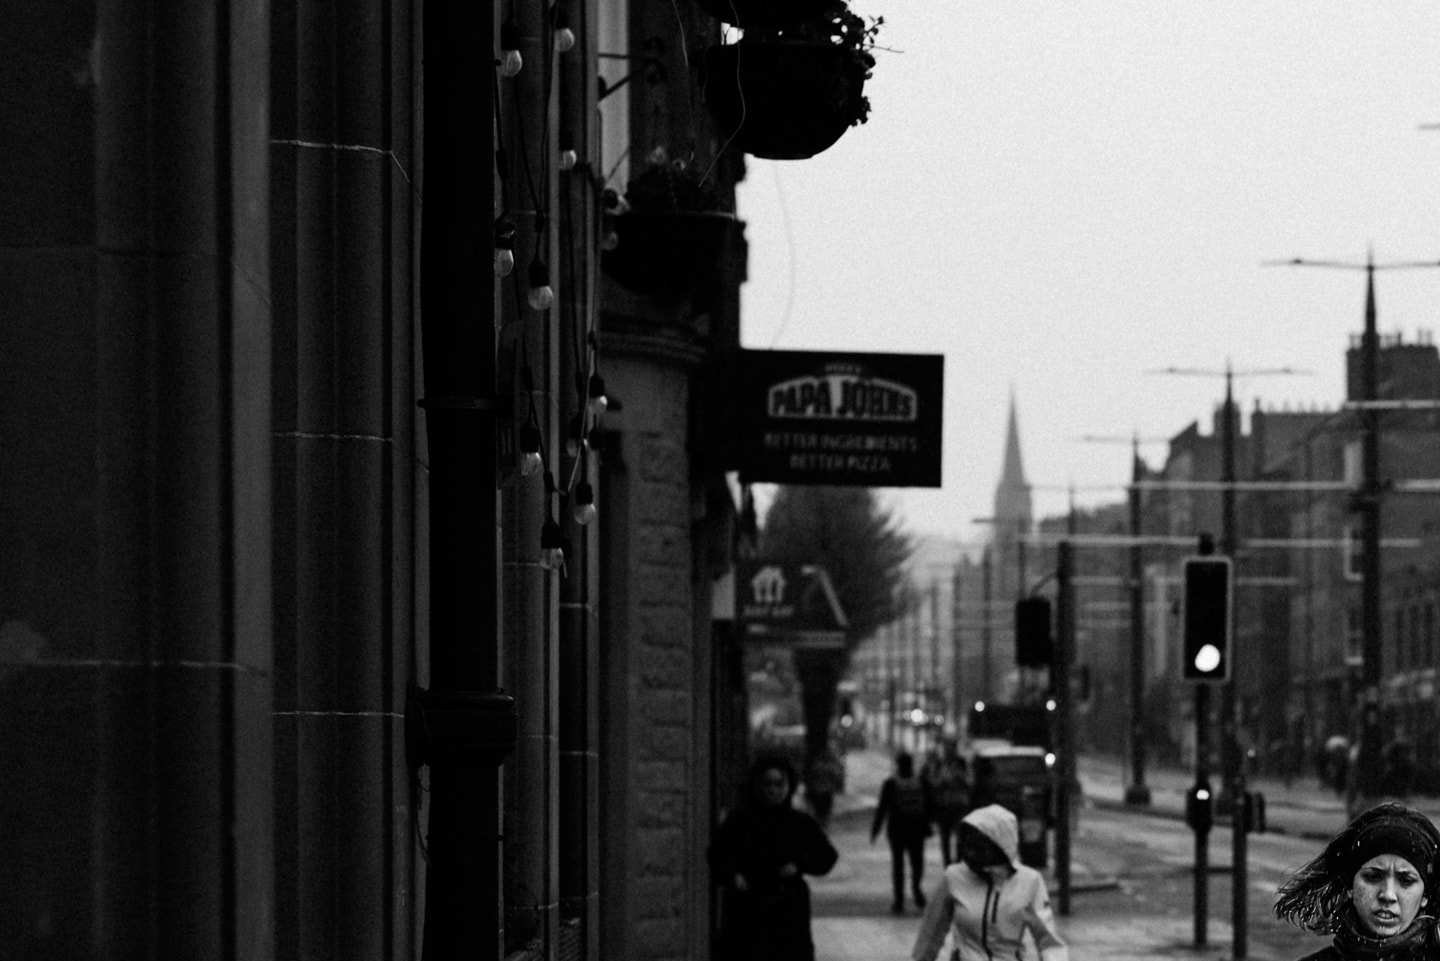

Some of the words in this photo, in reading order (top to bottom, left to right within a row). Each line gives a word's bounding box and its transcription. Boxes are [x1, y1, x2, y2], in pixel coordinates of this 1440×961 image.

[773, 380, 833, 415] PAPA
[789, 453, 845, 471] BETTER
[847, 454, 891, 472] PIZZA
